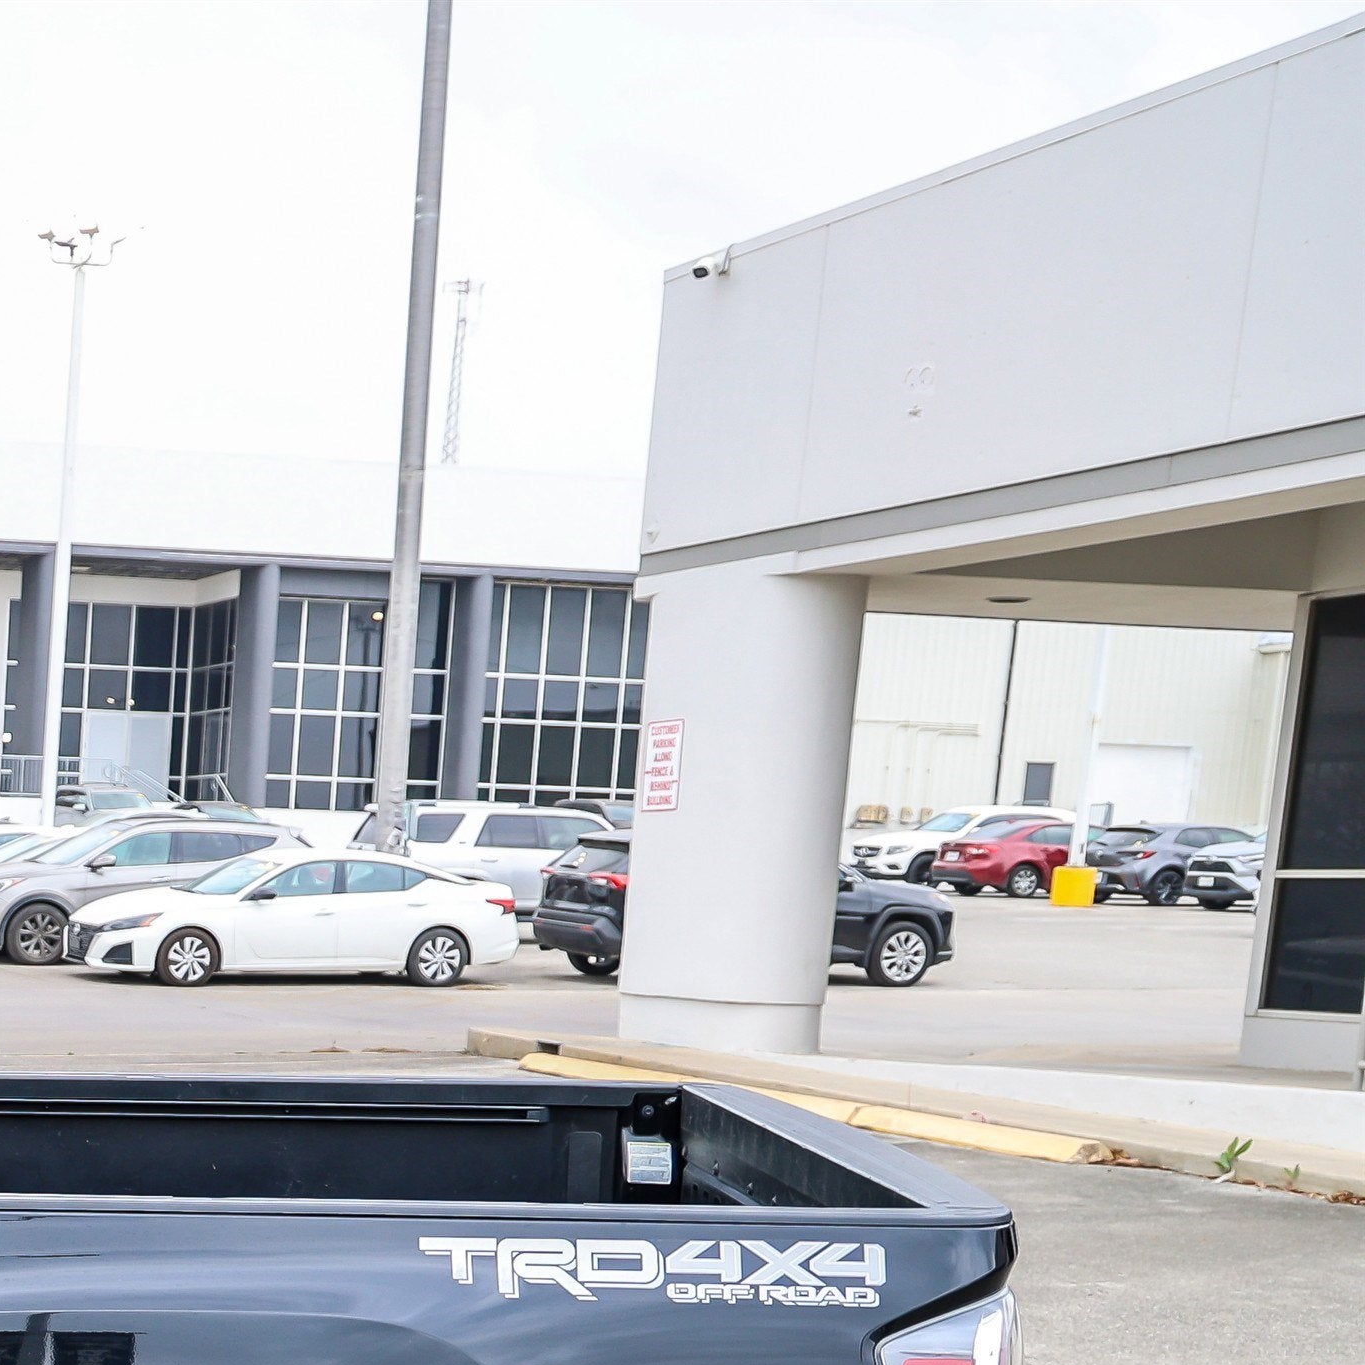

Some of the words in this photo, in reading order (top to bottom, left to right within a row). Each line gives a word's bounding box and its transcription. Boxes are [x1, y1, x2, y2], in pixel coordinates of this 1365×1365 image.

[651, 724, 680, 736] CUSTOMER
[653, 738, 676, 749] PARKING
[653, 751, 673, 762] ALONG
[651, 766, 668, 777] FENCE
[647, 795, 673, 806] BUILDING
[418, 1236, 665, 1301] TRD
[665, 1239, 887, 1287] 4X4
[666, 1282, 755, 1305] OFF
[758, 1286, 881, 1308] ROAD
